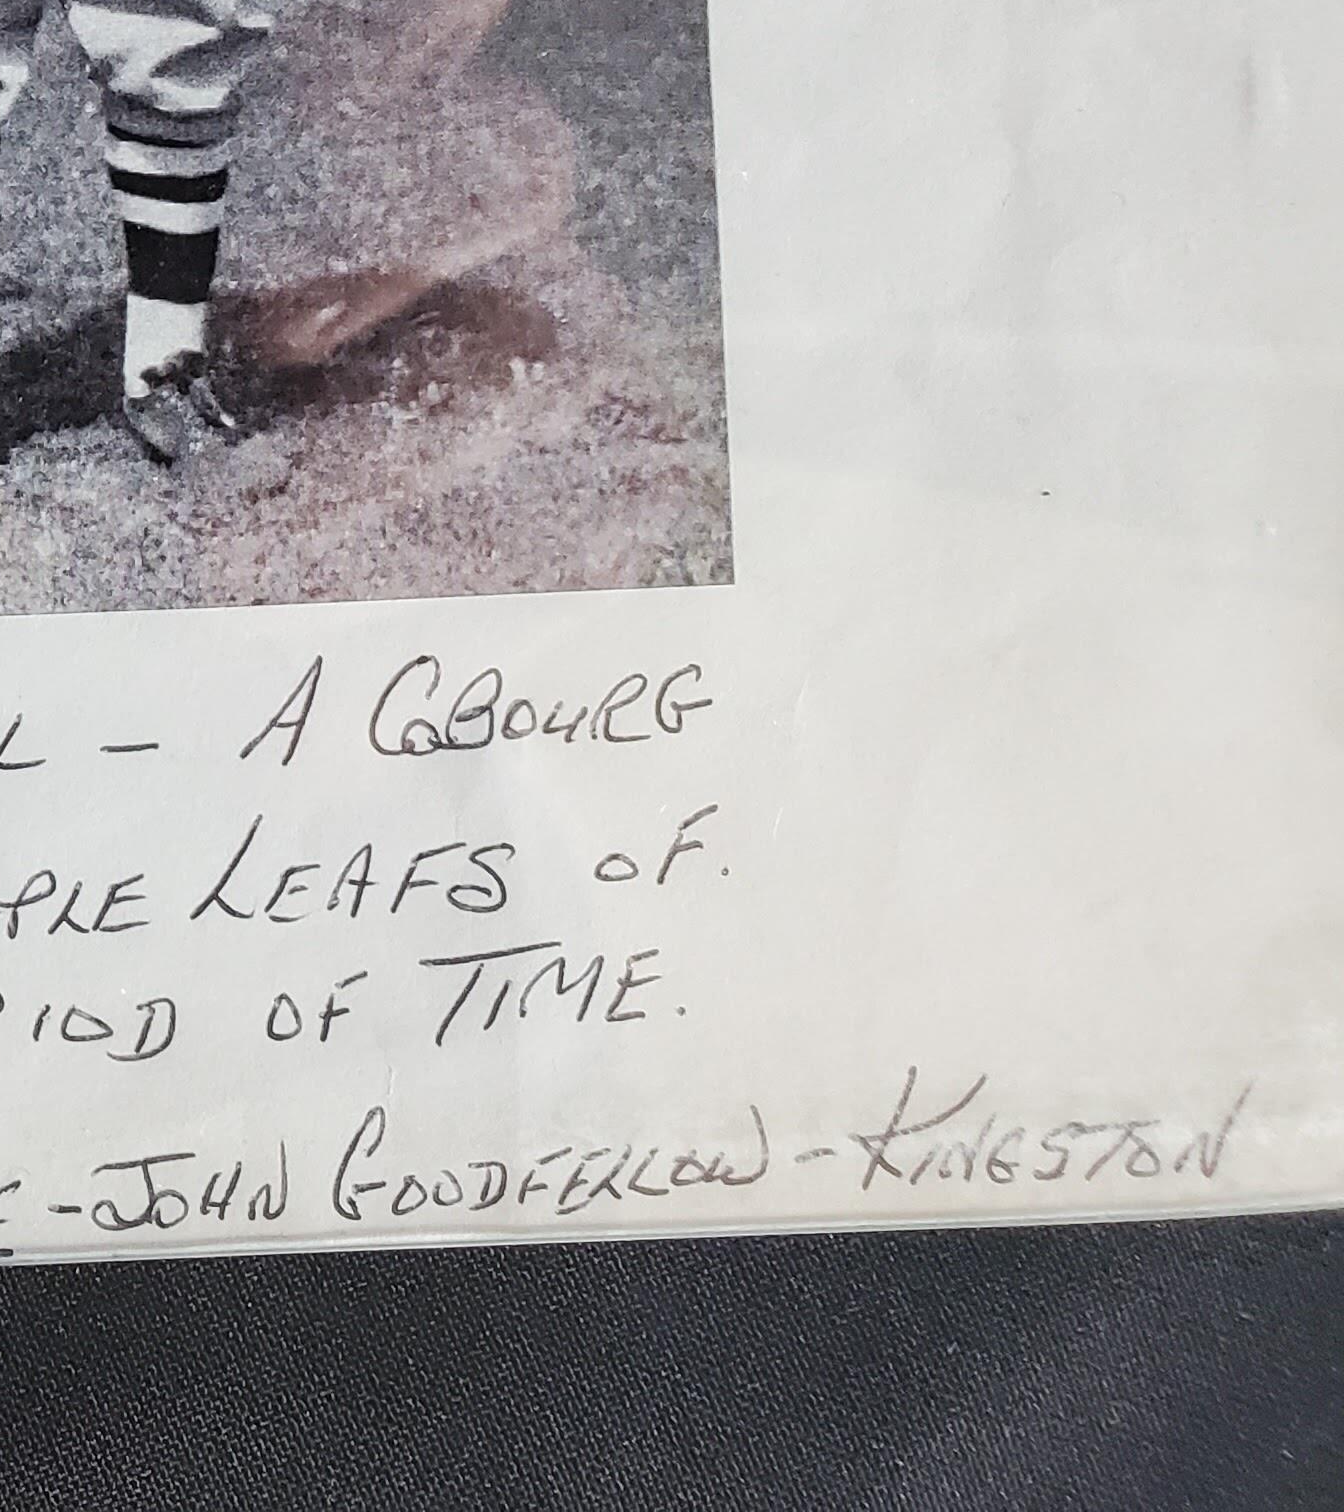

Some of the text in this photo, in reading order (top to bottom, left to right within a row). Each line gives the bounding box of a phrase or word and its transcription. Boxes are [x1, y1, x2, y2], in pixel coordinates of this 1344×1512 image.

[239, 655, 323, 766] A
[369, 655, 713, 756] COBOURG
[190, 814, 516, 923] LEAFS
[266, 971, 368, 1042] OF
[419, 942, 686, 1047] TIME.
[91, 1140, 288, 1231] JOHN
[332, 1105, 768, 1220] GOODFELLOW
[850, 1066, 1250, 1190] KINGSTON
